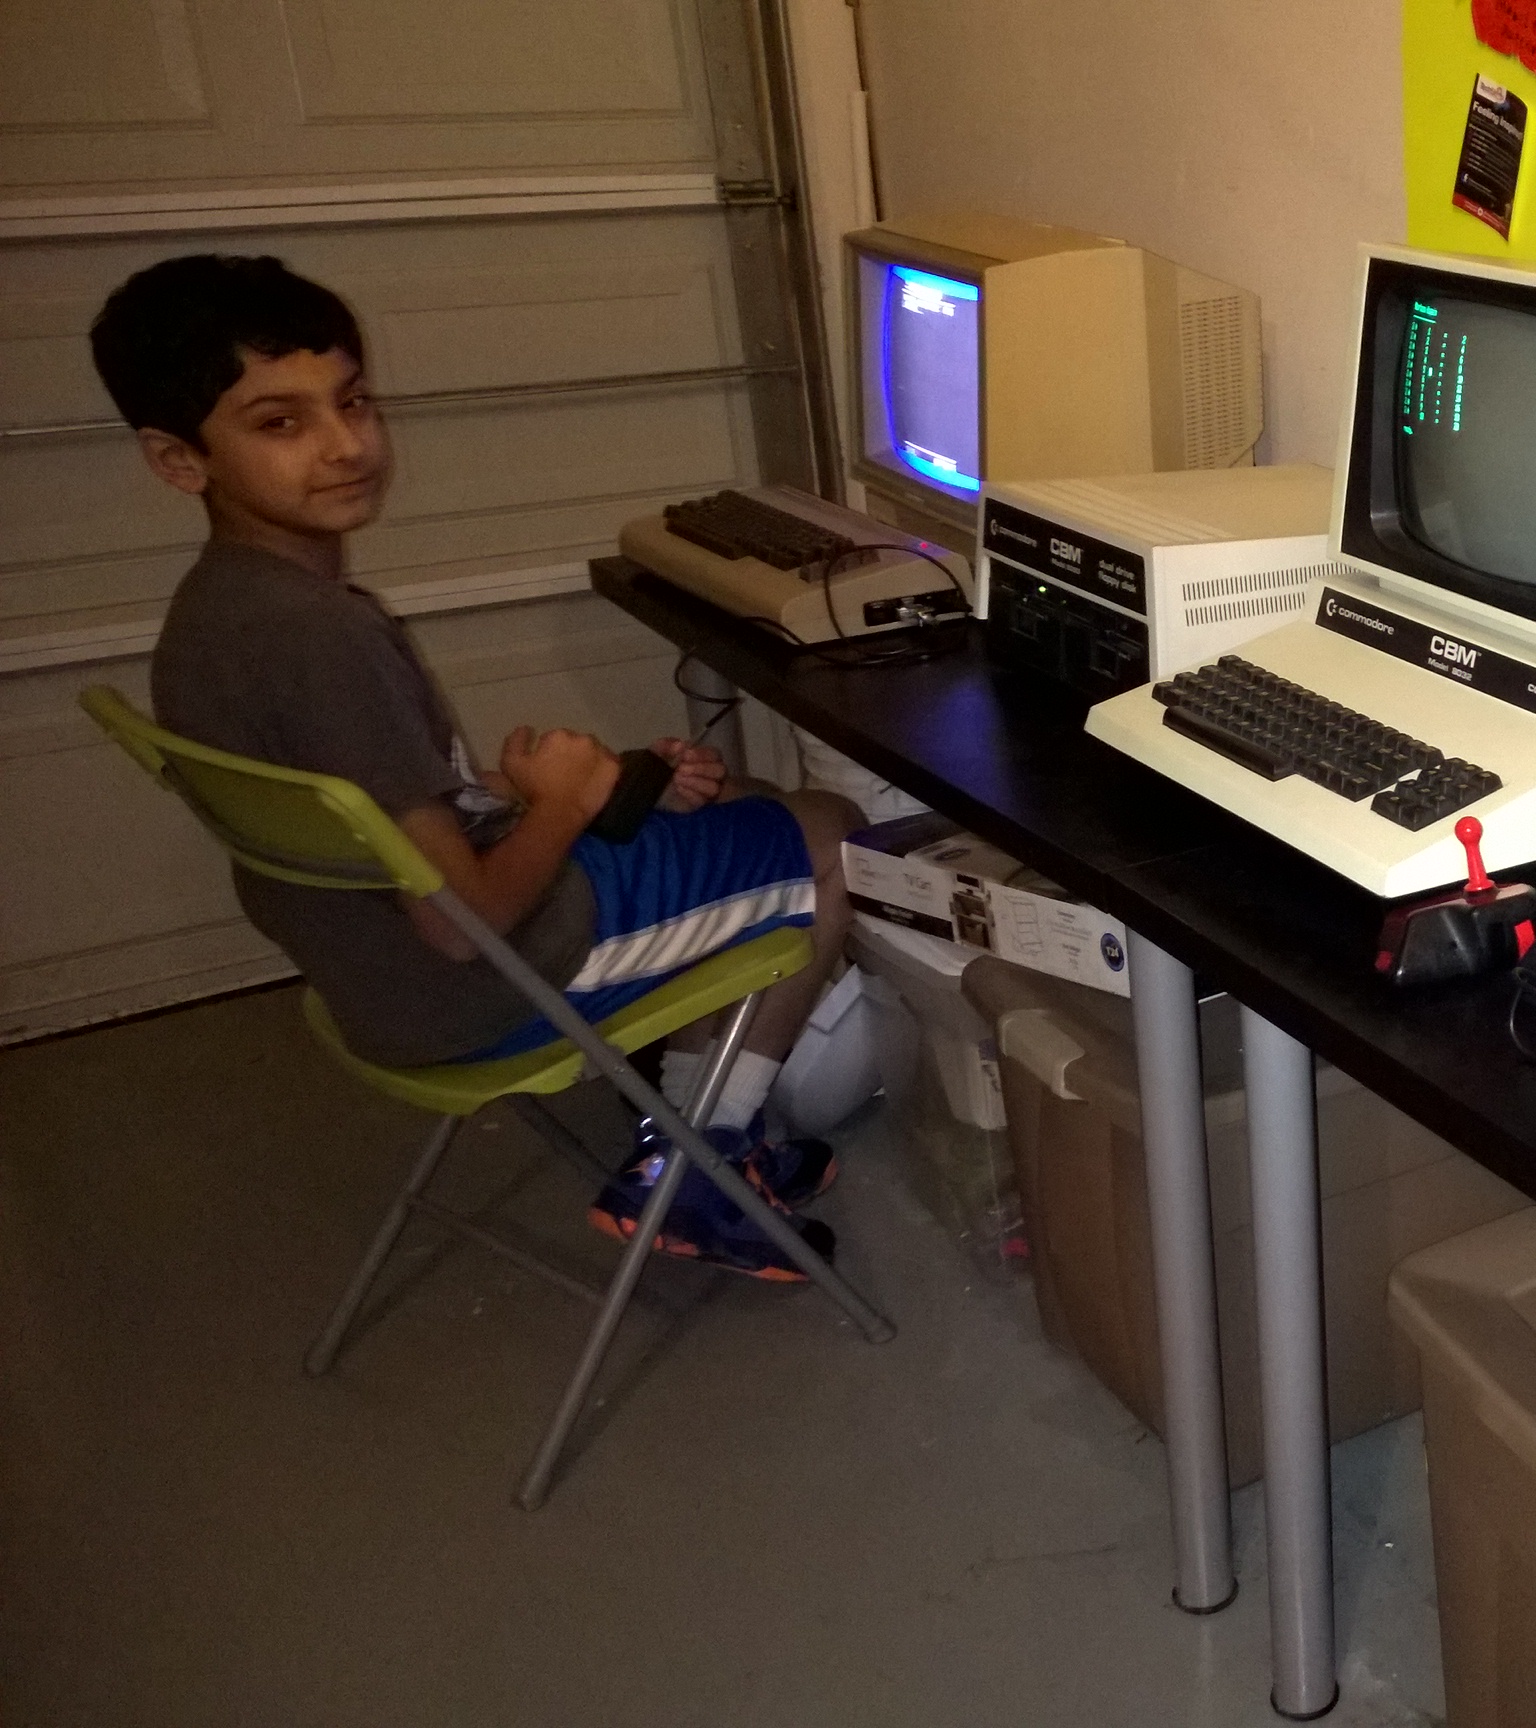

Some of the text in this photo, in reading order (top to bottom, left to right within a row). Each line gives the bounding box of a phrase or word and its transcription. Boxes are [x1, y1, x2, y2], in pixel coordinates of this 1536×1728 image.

[1050, 537, 1082, 564] CBM
[1338, 607, 1395, 635] commodore
[1427, 657, 1449, 672] Model
[1429, 635, 1476, 668] CBM
